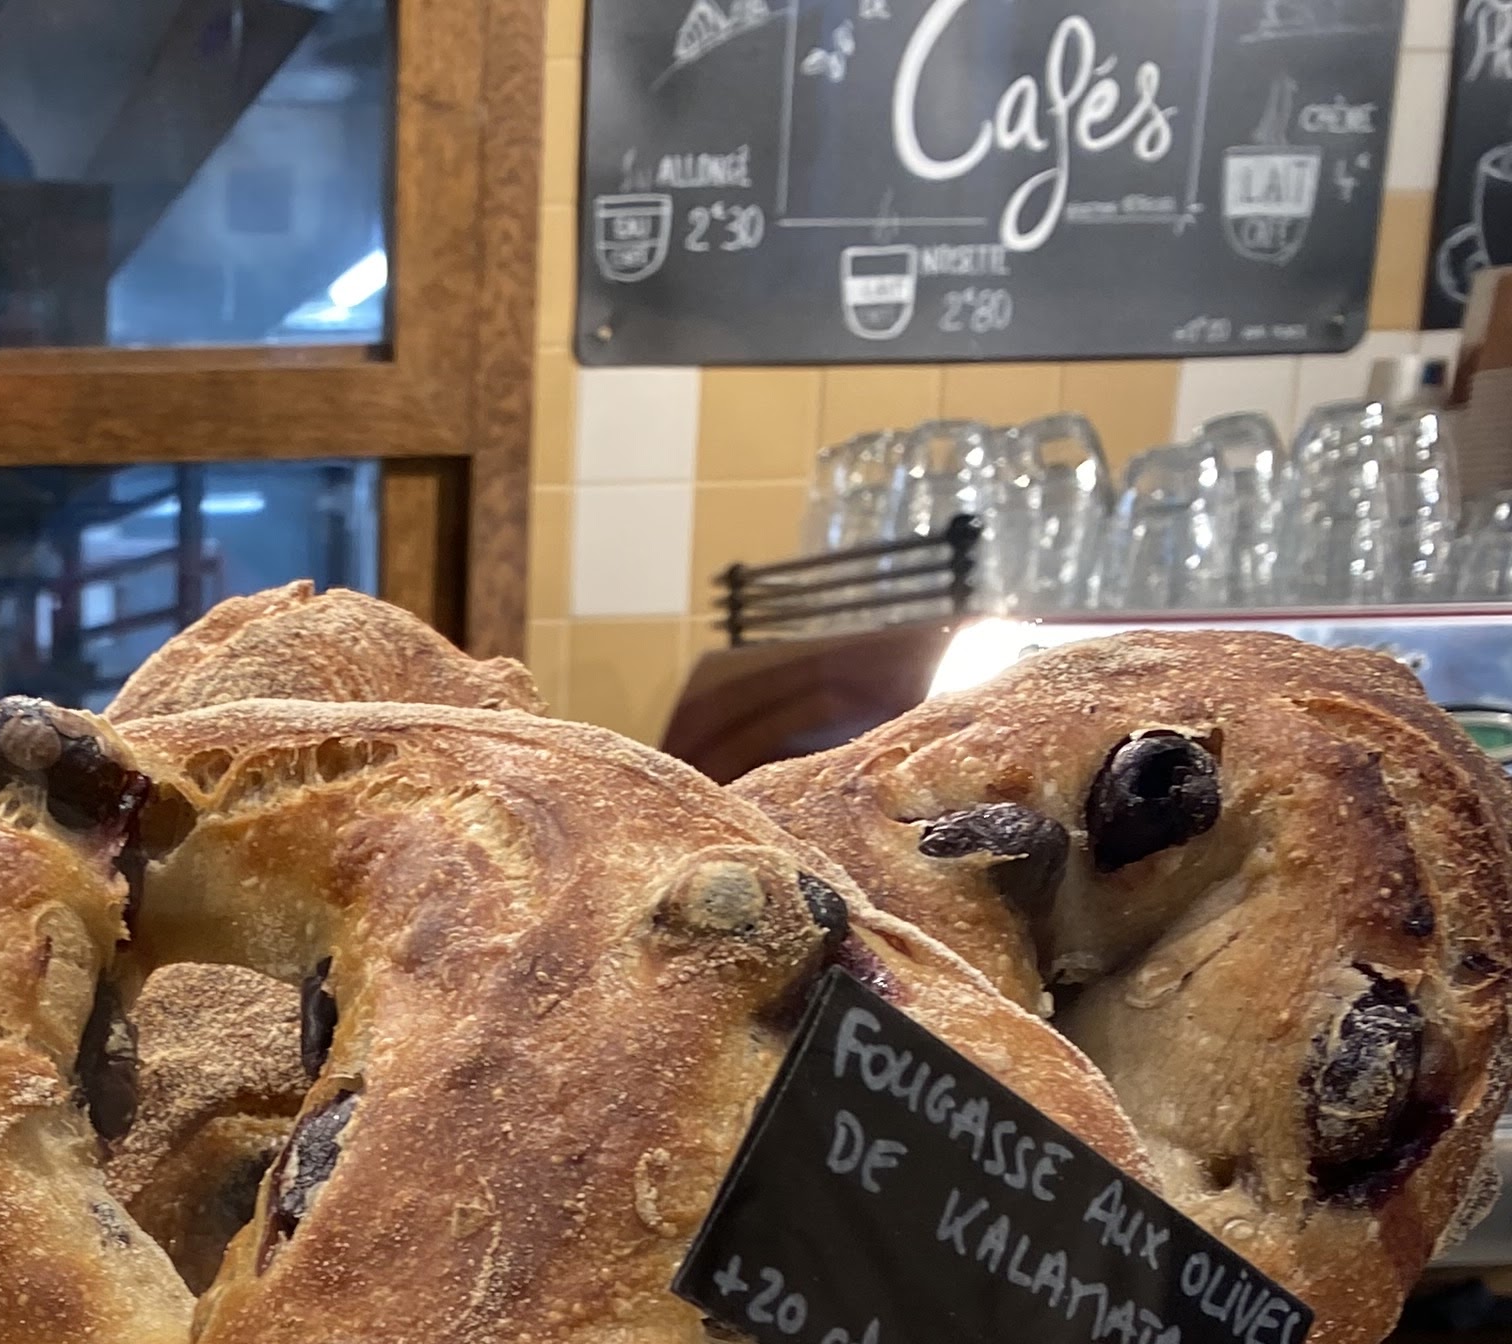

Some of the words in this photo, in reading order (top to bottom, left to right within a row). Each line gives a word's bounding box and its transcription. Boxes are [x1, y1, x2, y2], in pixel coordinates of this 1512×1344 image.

[892, 0, 1173, 251] Cafés
[826, 1109, 909, 1194] DE
[833, 1006, 1074, 1201] FOUGASSE
[1084, 1179, 1170, 1270] AUX
